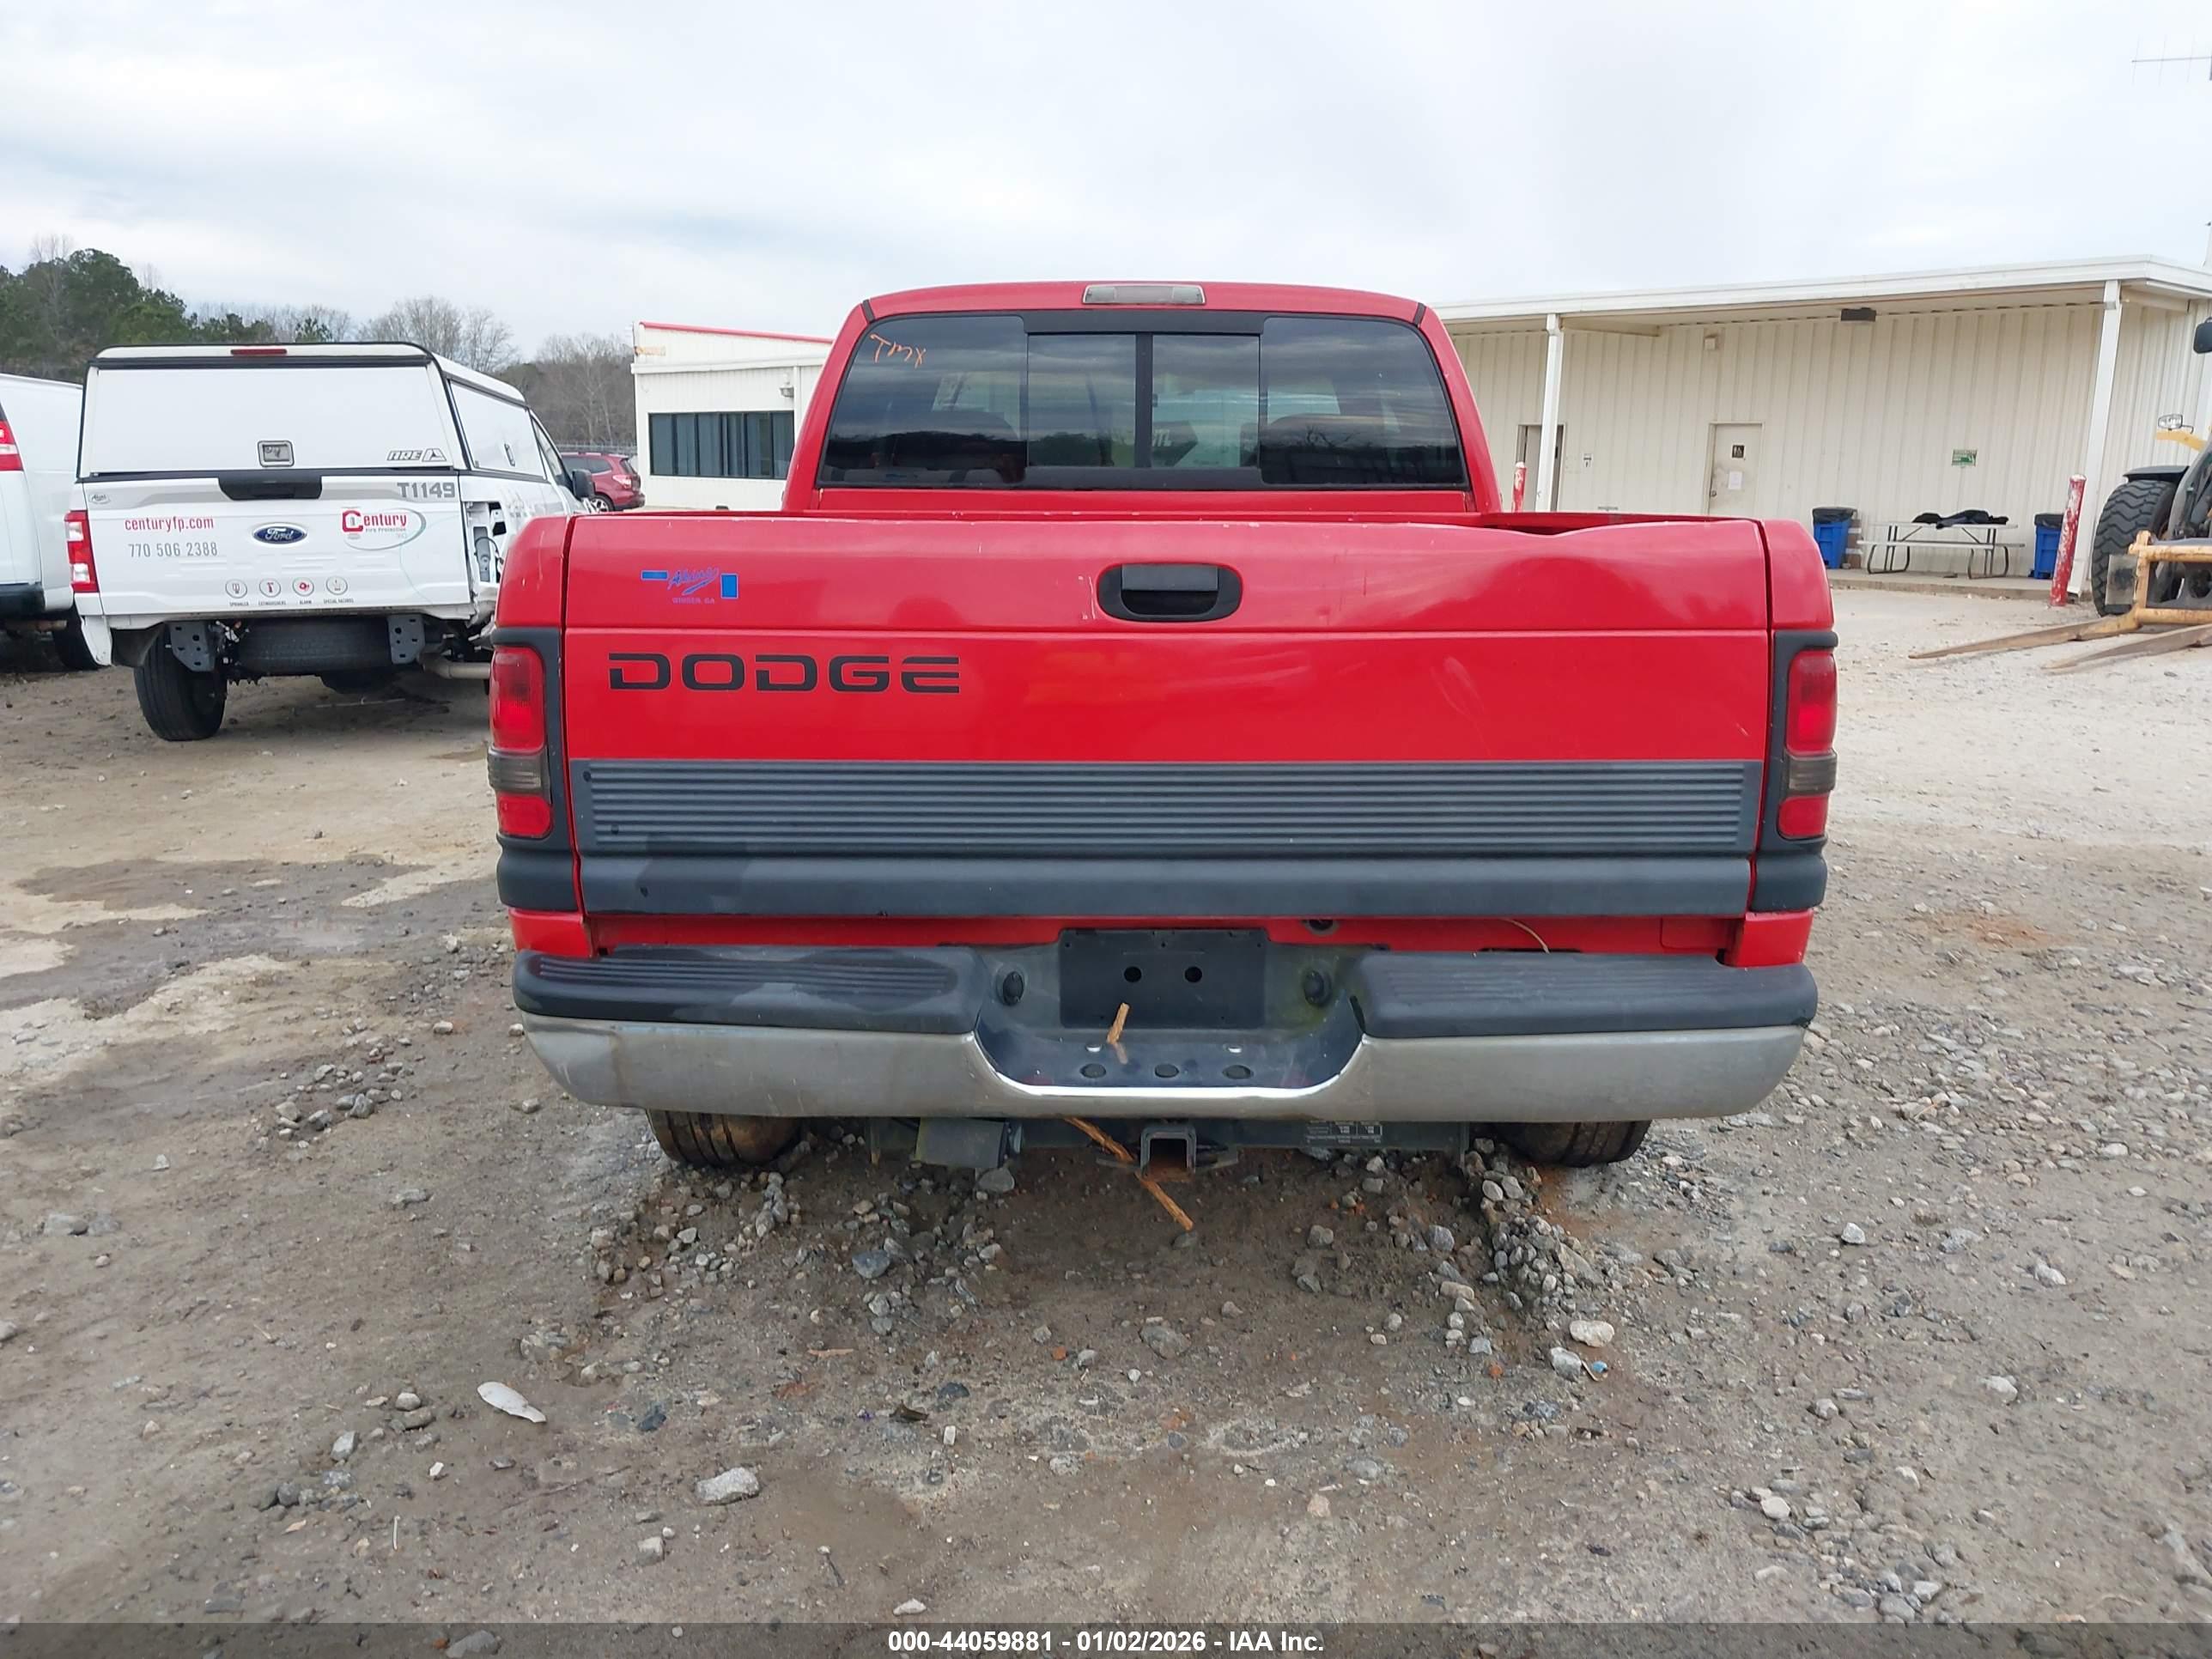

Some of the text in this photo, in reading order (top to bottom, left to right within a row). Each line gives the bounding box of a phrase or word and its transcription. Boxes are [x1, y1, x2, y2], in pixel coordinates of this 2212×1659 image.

[397, 482, 456, 498] T1149
[125, 516, 215, 532] centuryfp.com
[342, 509, 407, 532] Century
[264, 527, 295, 541] Ford
[129, 542, 218, 557] 770 506 2388
[608, 653, 960, 693] DODGE
